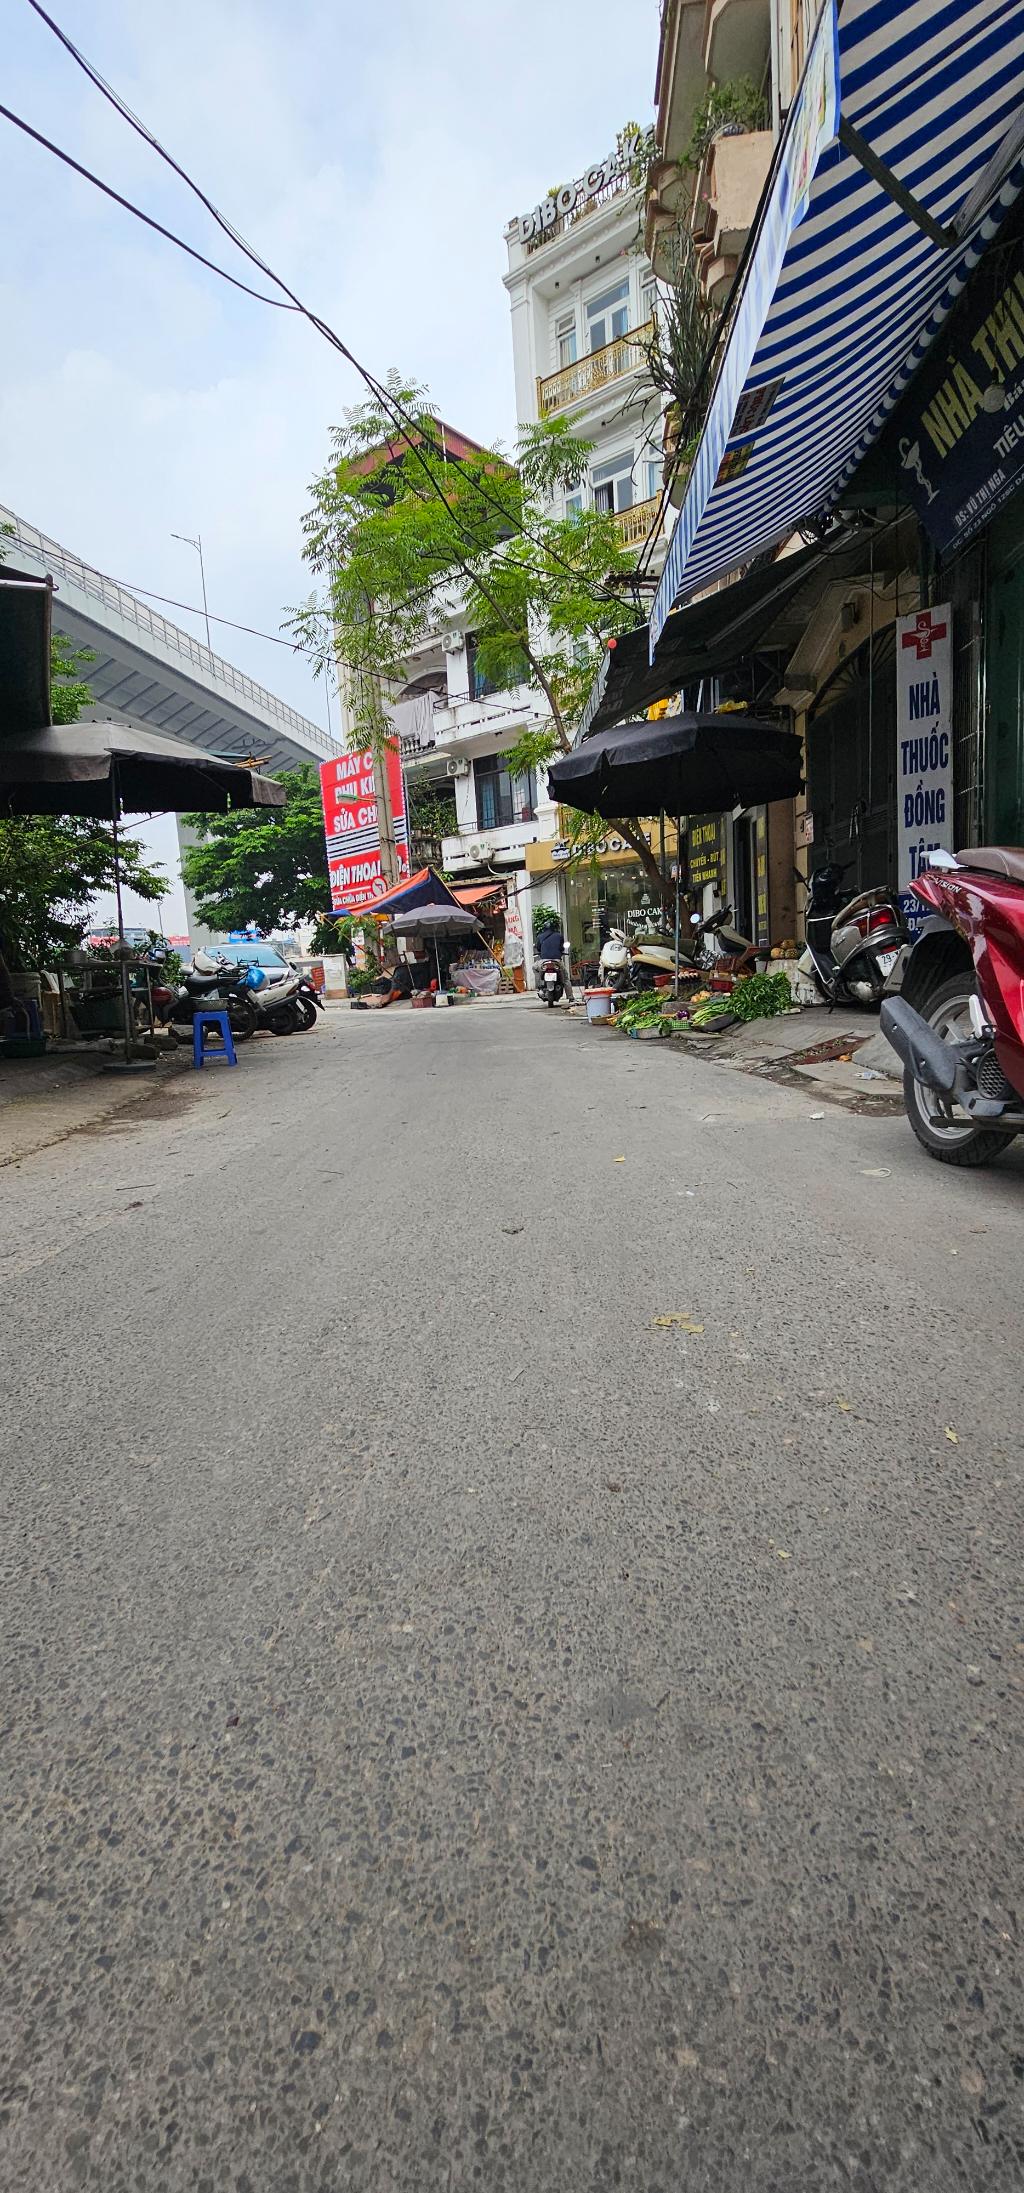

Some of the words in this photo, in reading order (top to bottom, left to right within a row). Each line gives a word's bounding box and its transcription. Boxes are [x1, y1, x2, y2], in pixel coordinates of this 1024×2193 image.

[518, 182, 577, 245] DIBO
[921, 355, 984, 459] NHÀ
[955, 510, 970, 527] DS:
[975, 484, 991, 504] THỊ
[988, 468, 1006, 492] NGA
[909, 671, 940, 721] NHÀ
[336, 754, 361, 781] MÁY
[363, 752, 374, 770] C
[901, 721, 949, 775] THUỐC
[334, 807, 356, 833] SỬA
[358, 804, 378, 826] CH
[904, 780, 945, 828] ĐỒNG
[330, 864, 351, 891] ĐIỆN
[933, 878, 963, 894] VISION
[627, 909, 646, 918] DIBO
